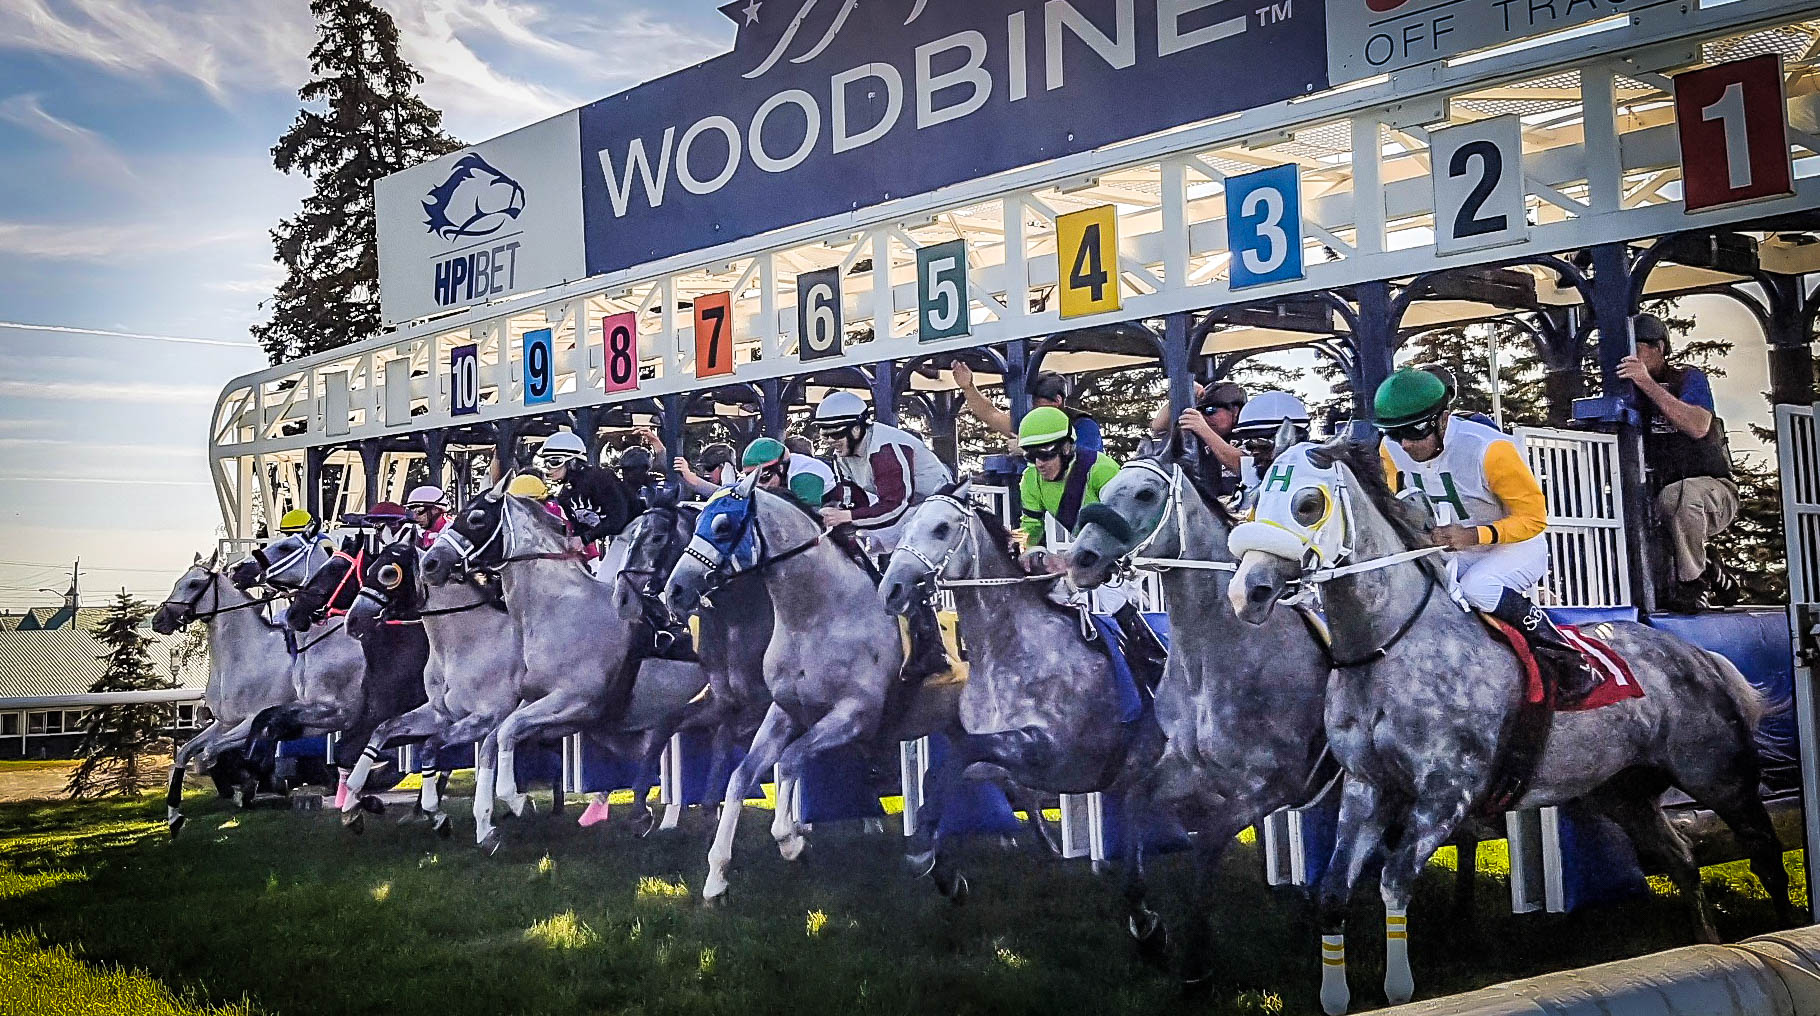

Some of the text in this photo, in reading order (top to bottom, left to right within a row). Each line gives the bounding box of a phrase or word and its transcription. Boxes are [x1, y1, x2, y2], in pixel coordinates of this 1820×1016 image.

[1365, 0, 1627, 66] OFF TRA
[598, 0, 1248, 218] WOODBINE
[1702, 82, 1752, 191] 1
[1449, 140, 1508, 239] 2
[1069, 223, 1108, 301] 4
[1241, 186, 1288, 275] 3
[434, 241, 521, 306] HPIBET
[927, 257, 960, 331] 5
[702, 305, 724, 369] 7
[806, 284, 836, 351] 6
[452, 355, 477, 409] 10
[529, 341, 548, 397] 9
[610, 325, 632, 385] 8
[1264, 465, 1295, 493] H
[1411, 472, 1470, 521] H
